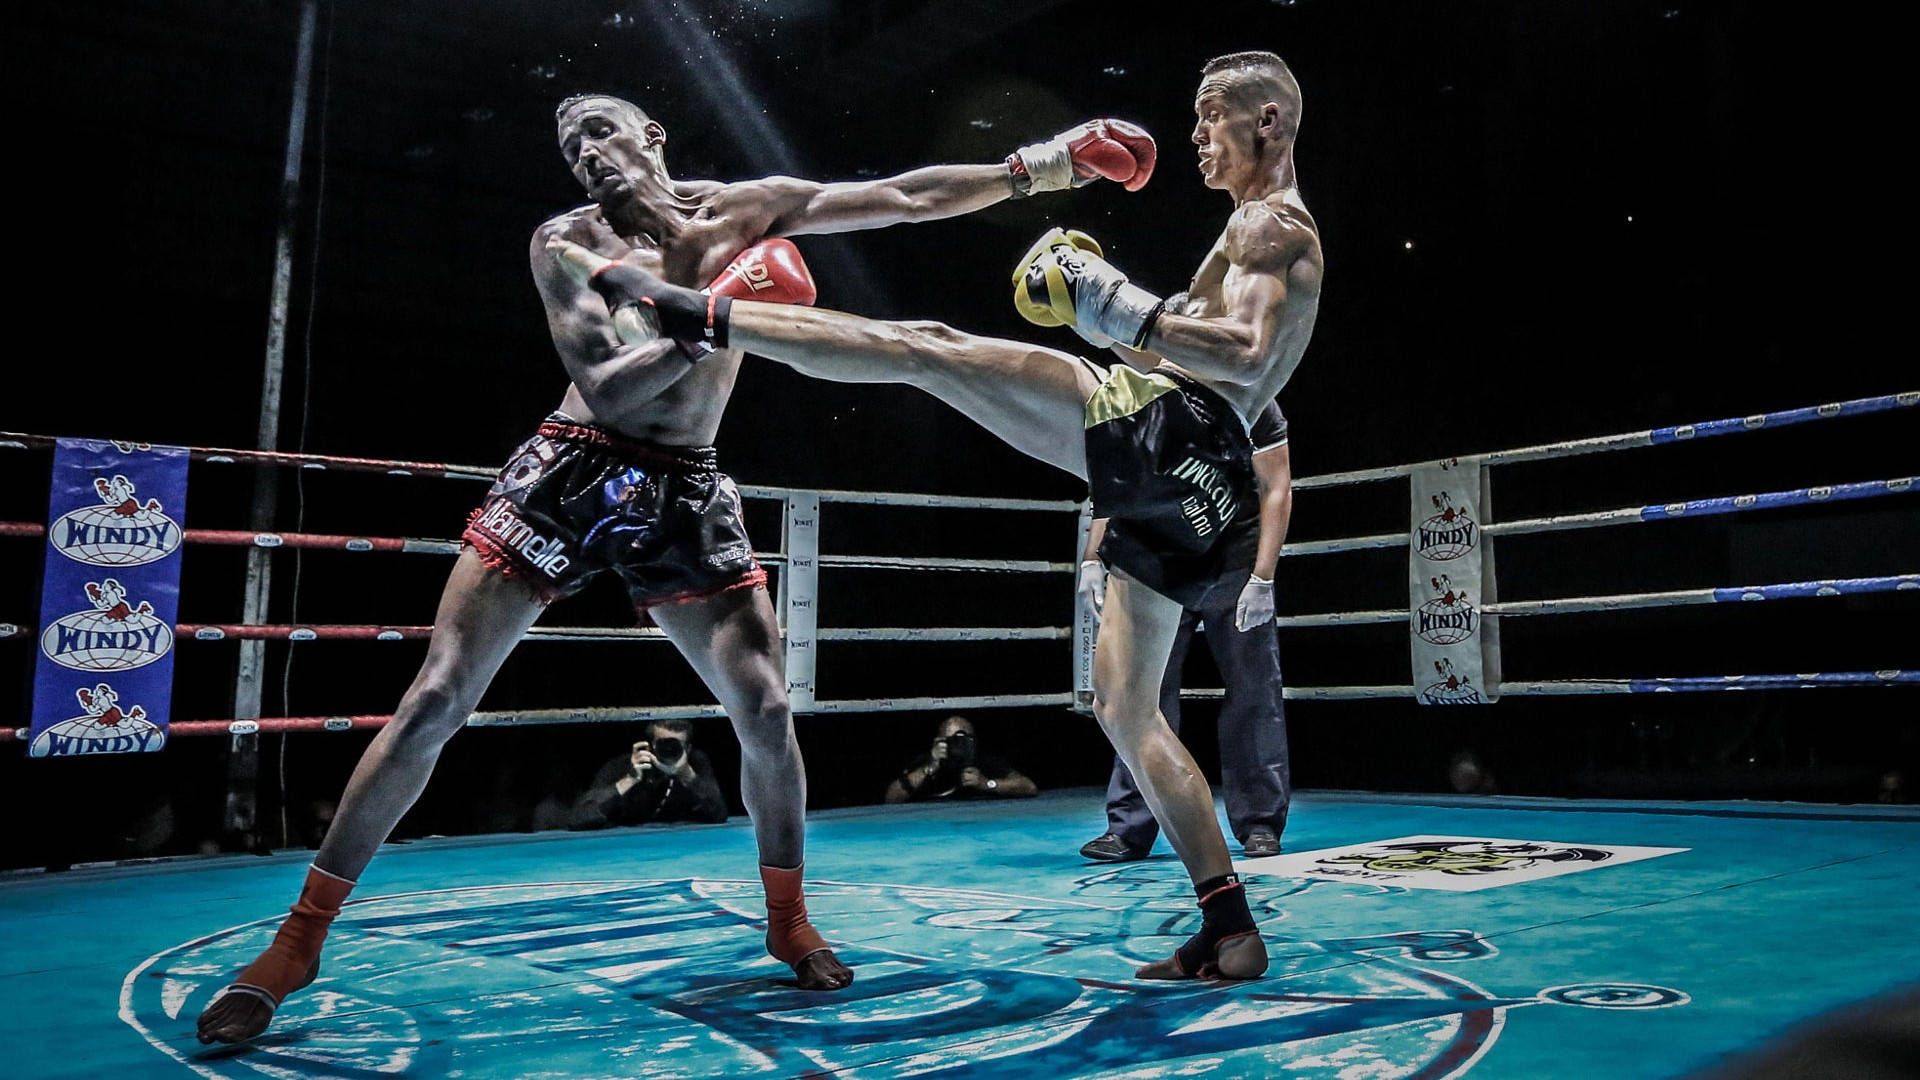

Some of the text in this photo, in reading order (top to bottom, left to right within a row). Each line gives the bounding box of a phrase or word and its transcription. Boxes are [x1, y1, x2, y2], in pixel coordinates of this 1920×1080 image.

[65, 517, 171, 550] WINDY
[1419, 521, 1474, 552] WINDY
[1419, 606, 1474, 634] WINDY
[56, 623, 162, 655] WINDY
[47, 728, 155, 755] WINDY
